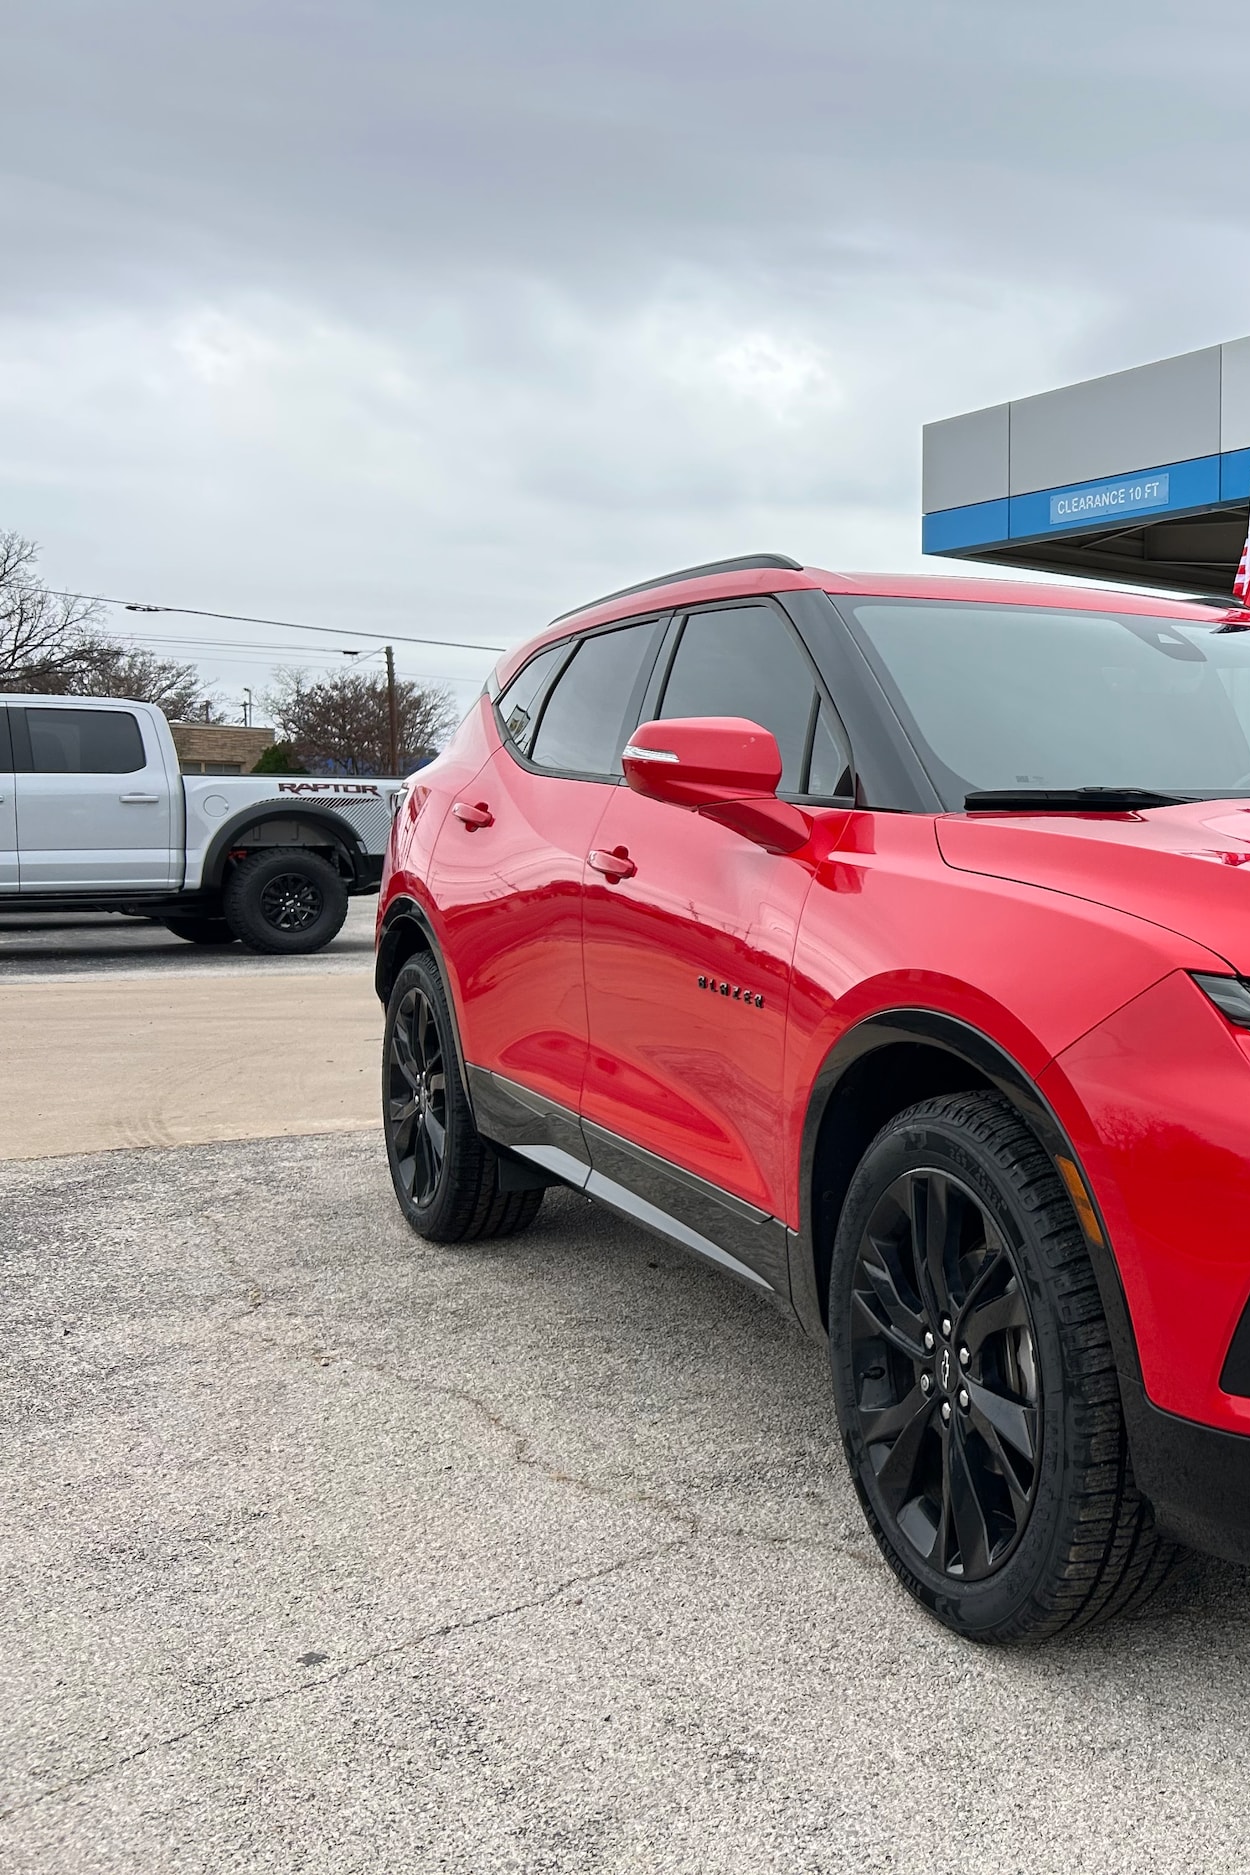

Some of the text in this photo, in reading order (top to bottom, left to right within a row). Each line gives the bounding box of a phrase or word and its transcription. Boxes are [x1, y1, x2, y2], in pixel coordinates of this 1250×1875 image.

[1057, 482, 1160, 515] CLEARANCE 10 FT
[278, 783, 382, 798] RAPTOR
[697, 975, 764, 1009] BLAZER
